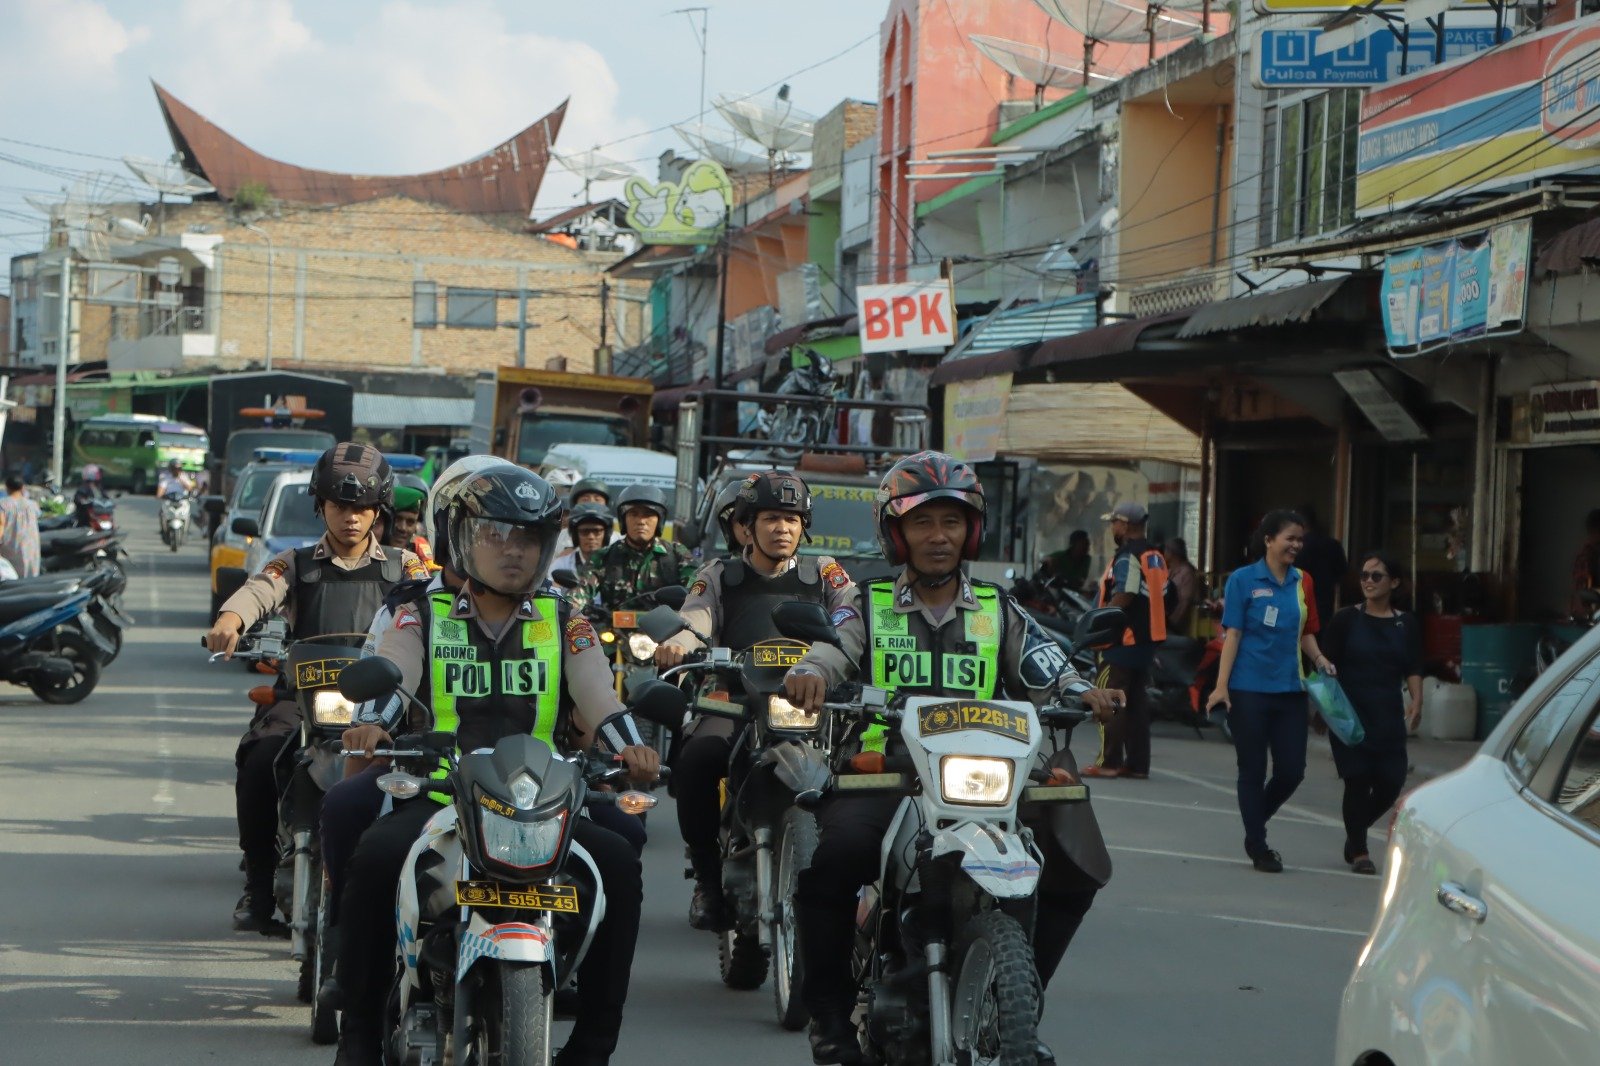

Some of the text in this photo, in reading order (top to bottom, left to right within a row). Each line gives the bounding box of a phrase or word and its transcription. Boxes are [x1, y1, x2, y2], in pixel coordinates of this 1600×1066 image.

[1446, 31, 1496, 43] PAKET
[864, 293, 947, 340] BPK
[888, 638, 913, 649] RIAN
[435, 646, 475, 660] AGUNG
